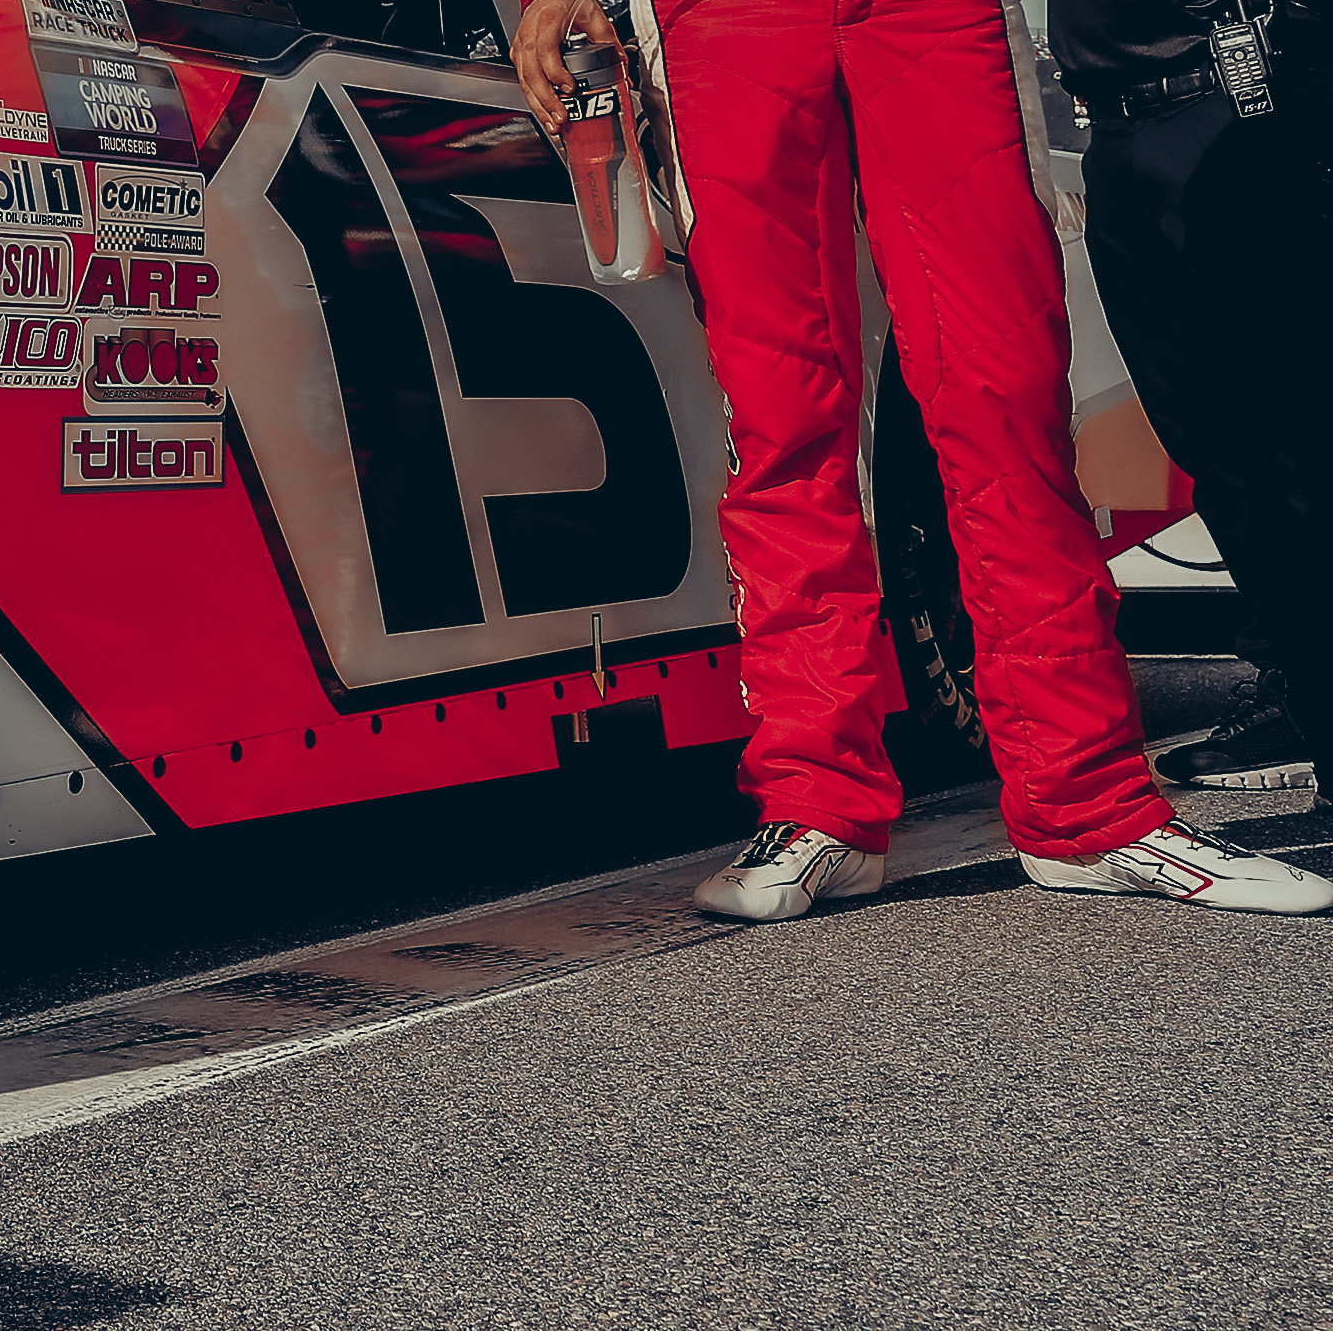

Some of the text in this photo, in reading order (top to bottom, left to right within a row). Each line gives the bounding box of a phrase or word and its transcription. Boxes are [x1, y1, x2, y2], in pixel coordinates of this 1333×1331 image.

[32, 11, 130, 43] RACE TRUCK
[91, 59, 137, 82] NASCAR
[78, 80, 152, 109] CAMPING
[585, 91, 614, 118] 15
[1244, 100, 1268, 113] 15-17
[83, 101, 158, 135] WORLD
[6, 212, 20, 224] OIL
[21, 213, 29, 224] &
[30, 214, 84, 228] LUBRICANTS
[110, 211, 150, 220] GASKET
[76, 257, 220, 311] ARP
[94, 329, 219, 385] KOOKS
[264, 81, 693, 636] 15
[4, 374, 79, 386] COATINGS
[102, 389, 140, 399] HEADERS
[161, 390, 196, 399] EXHAUST
[72, 429, 215, 479] tilton
